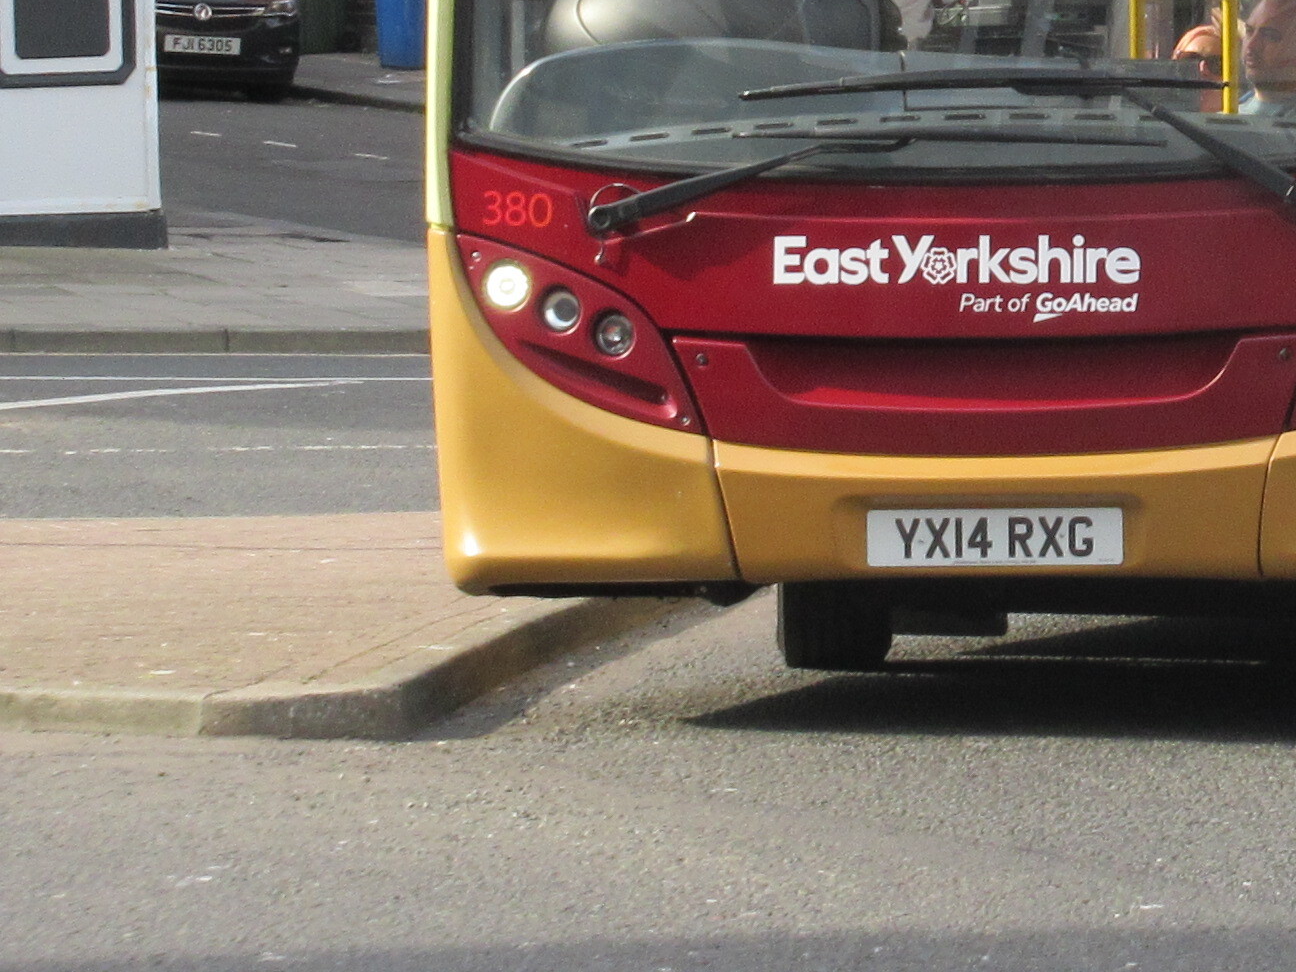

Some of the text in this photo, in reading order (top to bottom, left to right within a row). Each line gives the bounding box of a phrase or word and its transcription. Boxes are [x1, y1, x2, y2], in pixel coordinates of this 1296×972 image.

[482, 192, 553, 228] 380
[773, 235, 889, 284] East
[959, 293, 1139, 313] Part of GoAhead
[895, 516, 1095, 559] YX14 RXG
